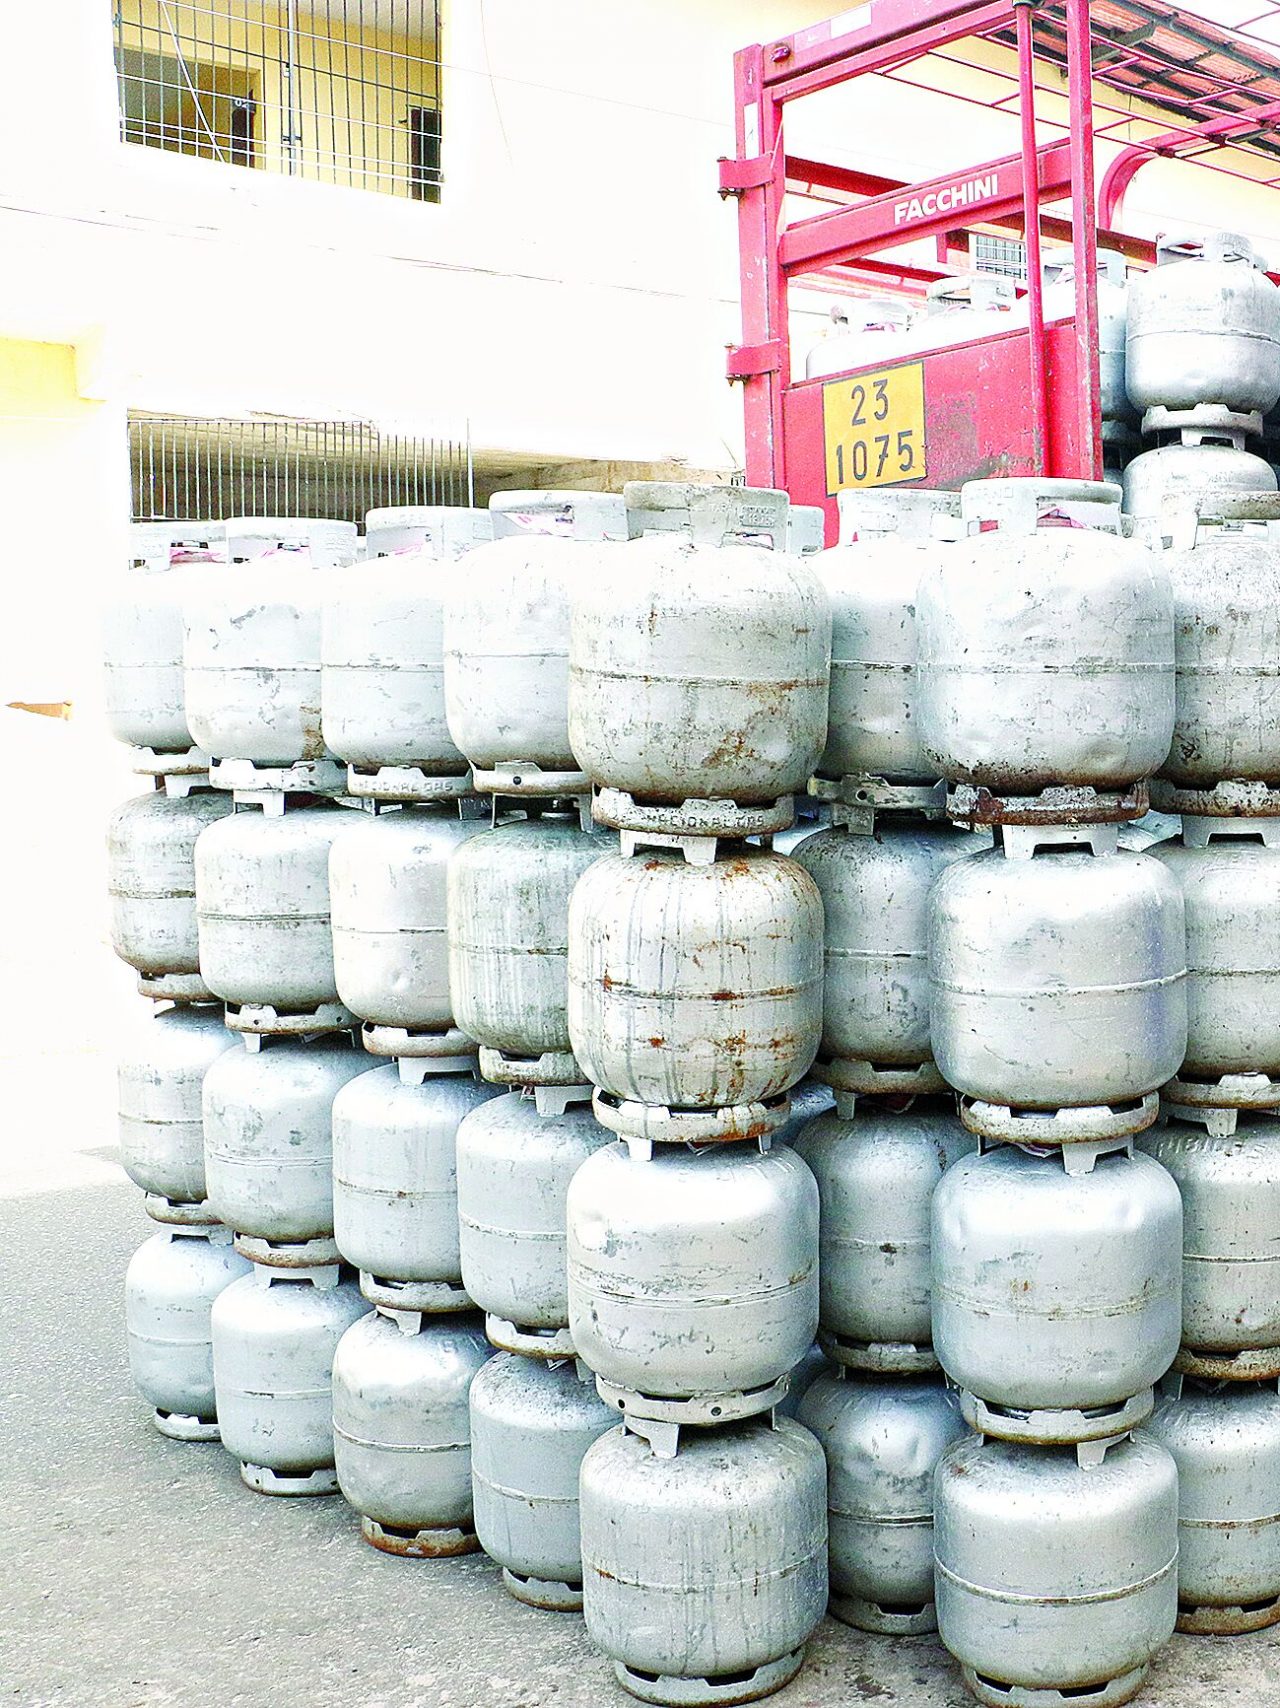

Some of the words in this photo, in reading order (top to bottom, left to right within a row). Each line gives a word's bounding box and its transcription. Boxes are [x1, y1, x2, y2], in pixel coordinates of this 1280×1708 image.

[894, 174, 998, 225] FACCHINI
[851, 378, 888, 426] 23
[836, 430, 913, 484] 1075
